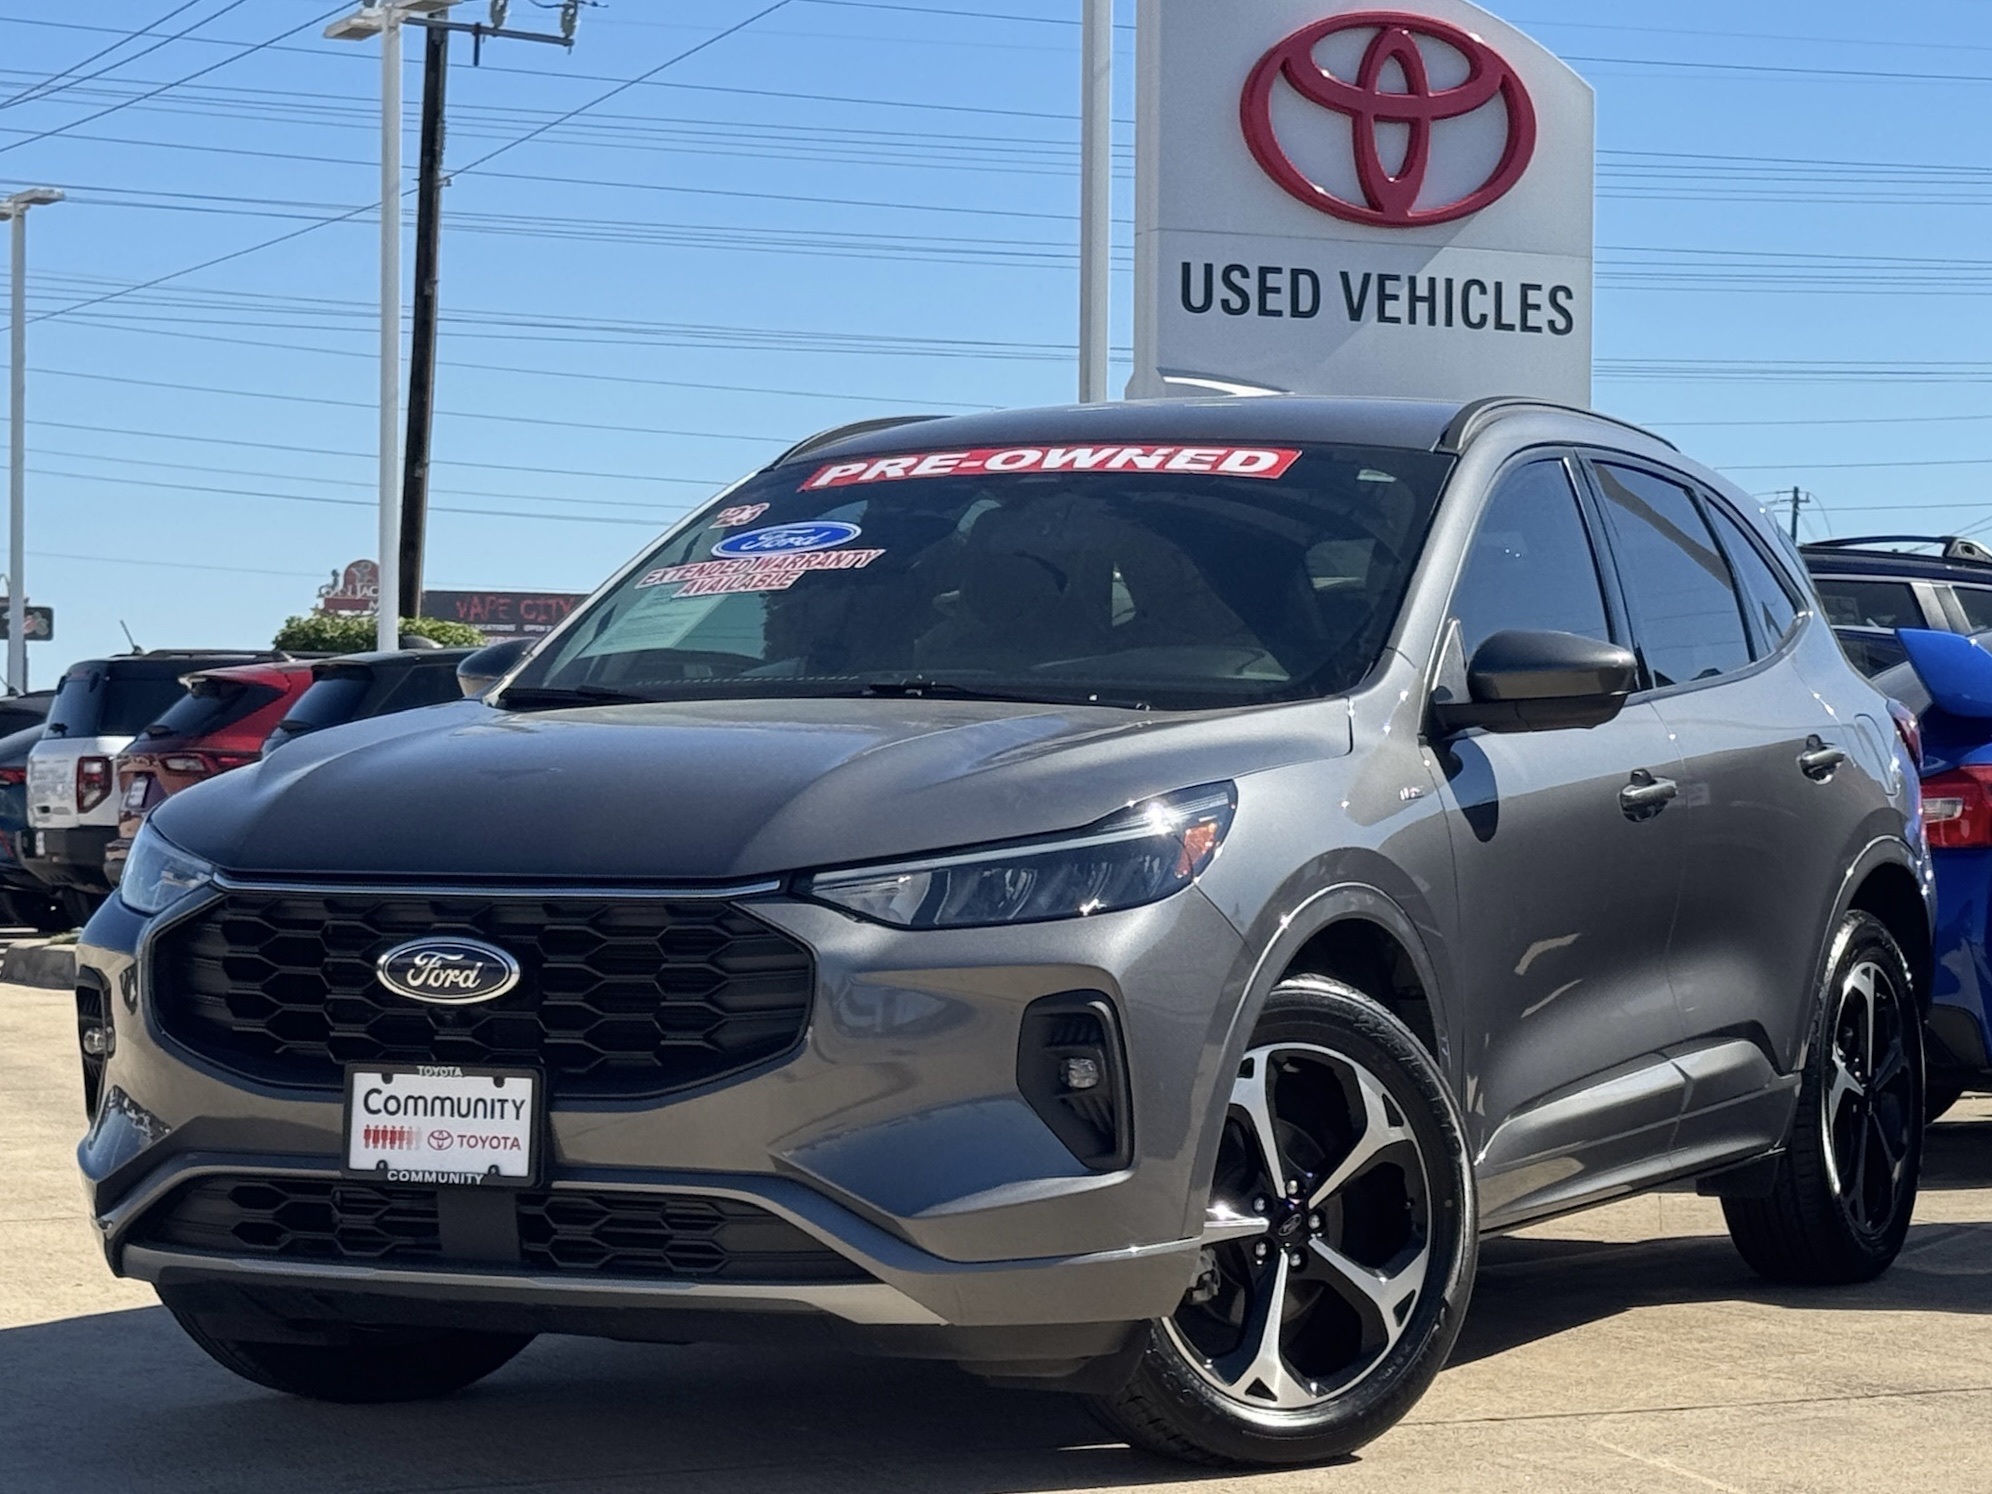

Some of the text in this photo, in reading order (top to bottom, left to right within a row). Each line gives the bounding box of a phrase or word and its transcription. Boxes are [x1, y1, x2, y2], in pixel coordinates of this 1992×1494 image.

[1180, 261, 1574, 336] USED VEHICLES
[809, 446, 1281, 489] PRE-OWNED
[739, 527, 834, 551] Ford
[639, 550, 882, 586] EXTENDED WARRANTY
[680, 570, 799, 596] AVAILABLE
[455, 594, 576, 623] VAPE CITY
[406, 951, 484, 988] Ford
[416, 1065, 464, 1077] TOYOTA
[456, 1133, 522, 1150] TOYOTA
[386, 1170, 485, 1185] COMMUNITY
